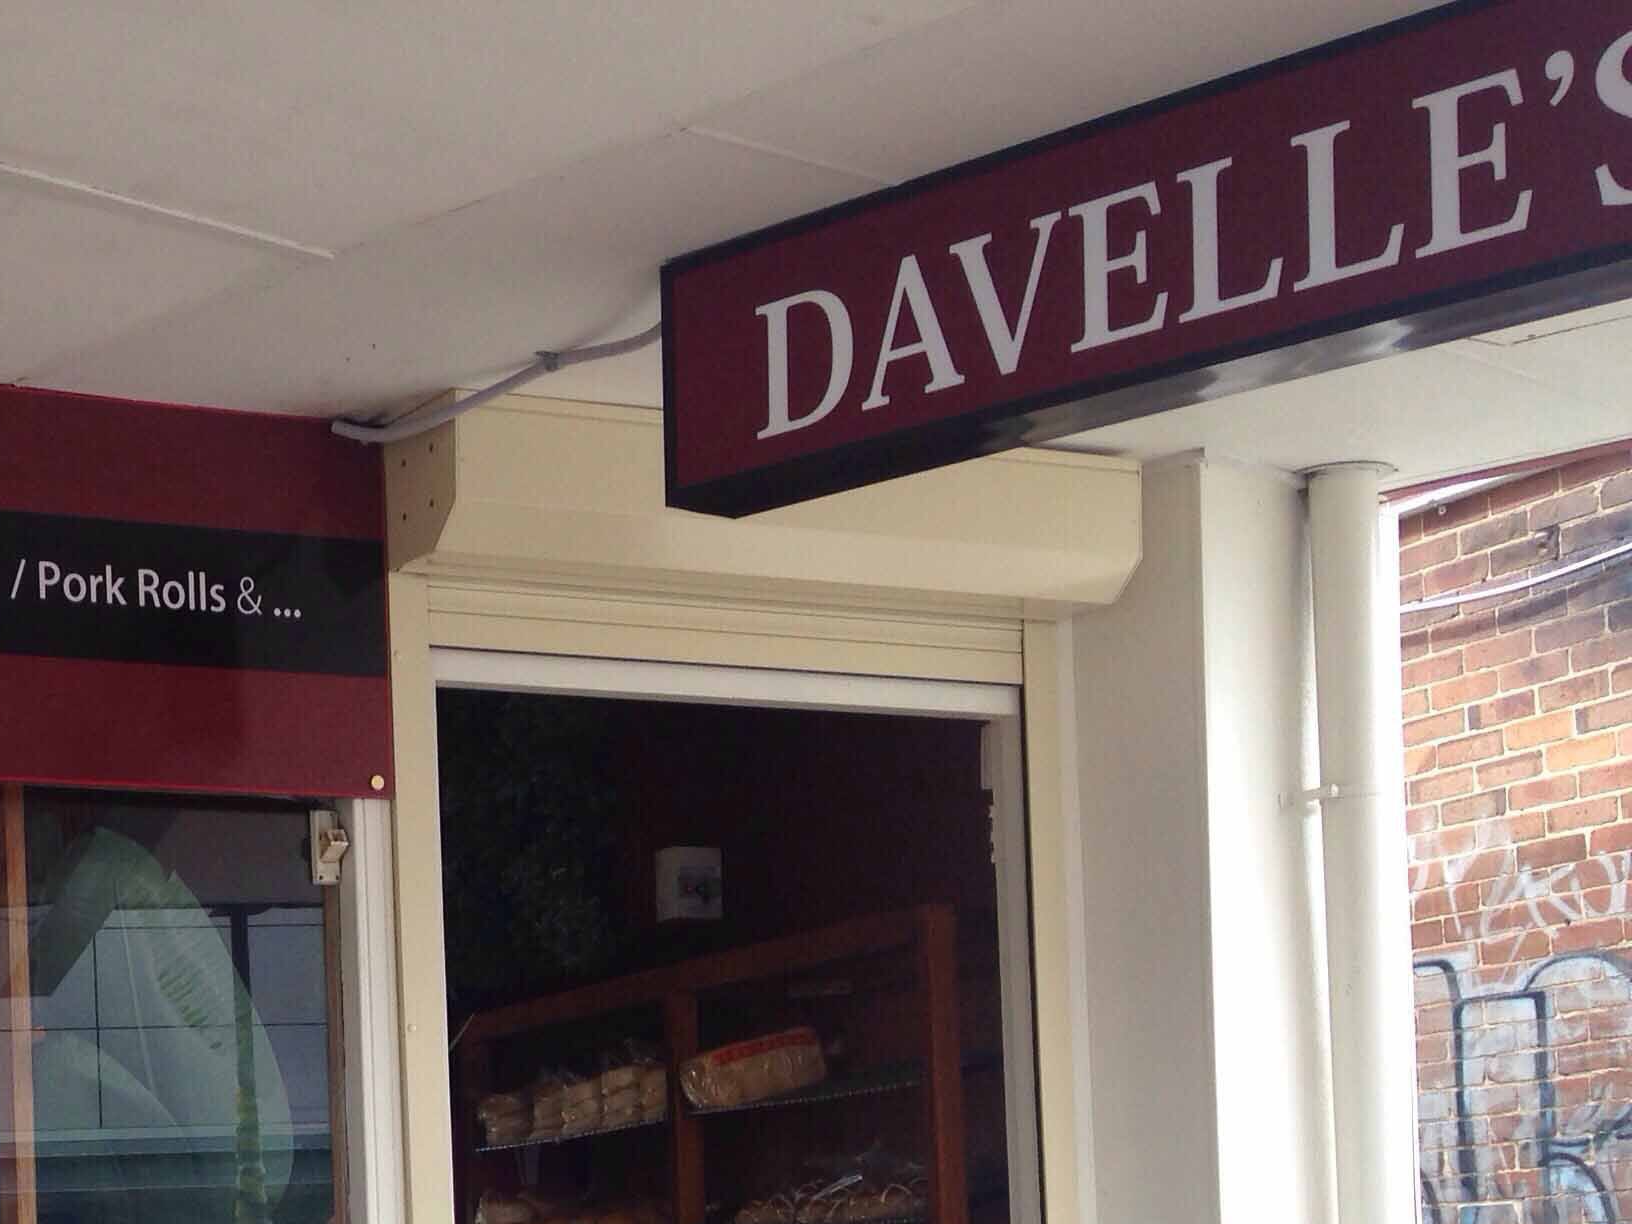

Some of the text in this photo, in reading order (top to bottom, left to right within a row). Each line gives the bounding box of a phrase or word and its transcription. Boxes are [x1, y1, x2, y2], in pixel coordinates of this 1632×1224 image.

[11, 559, 26, 600] /
[39, 560, 126, 606] Pork
[138, 568, 227, 612] Rolls
[236, 576, 264, 616] &
